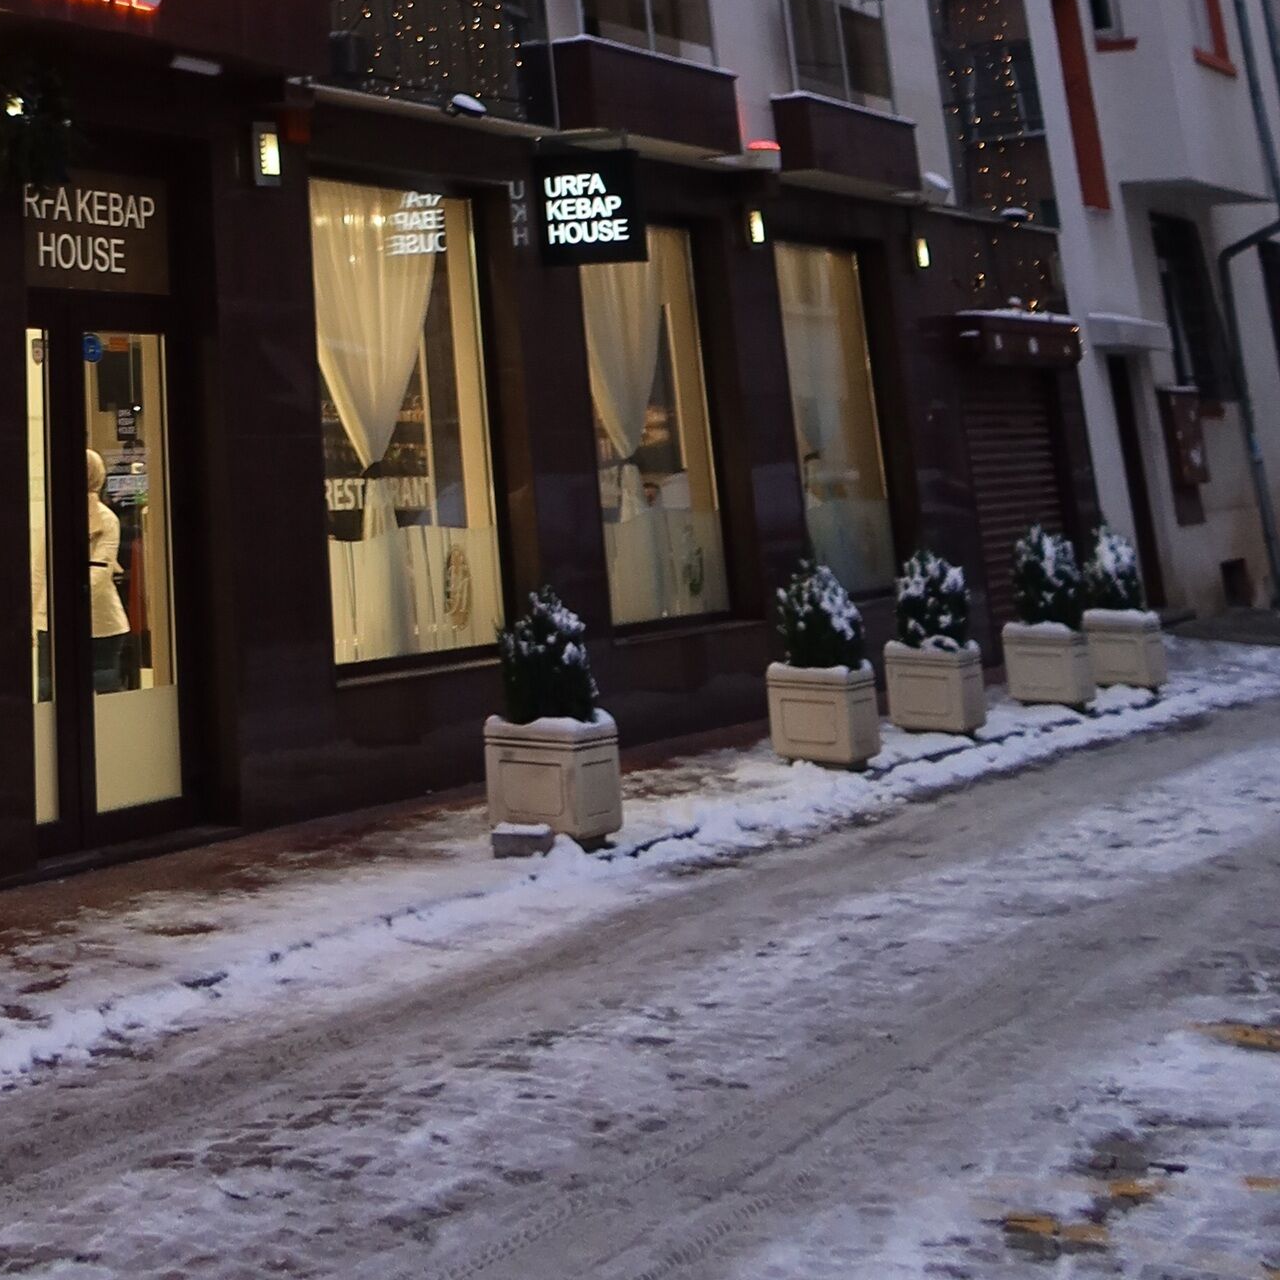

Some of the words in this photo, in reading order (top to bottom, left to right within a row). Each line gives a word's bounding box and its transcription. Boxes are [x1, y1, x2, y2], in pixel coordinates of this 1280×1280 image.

[543, 172, 607, 198] URFA
[75, 189, 155, 229] KEBAP
[545, 195, 622, 221] KEBAP
[547, 218, 631, 245] HOUSE
[38, 232, 126, 273] HOUSE
